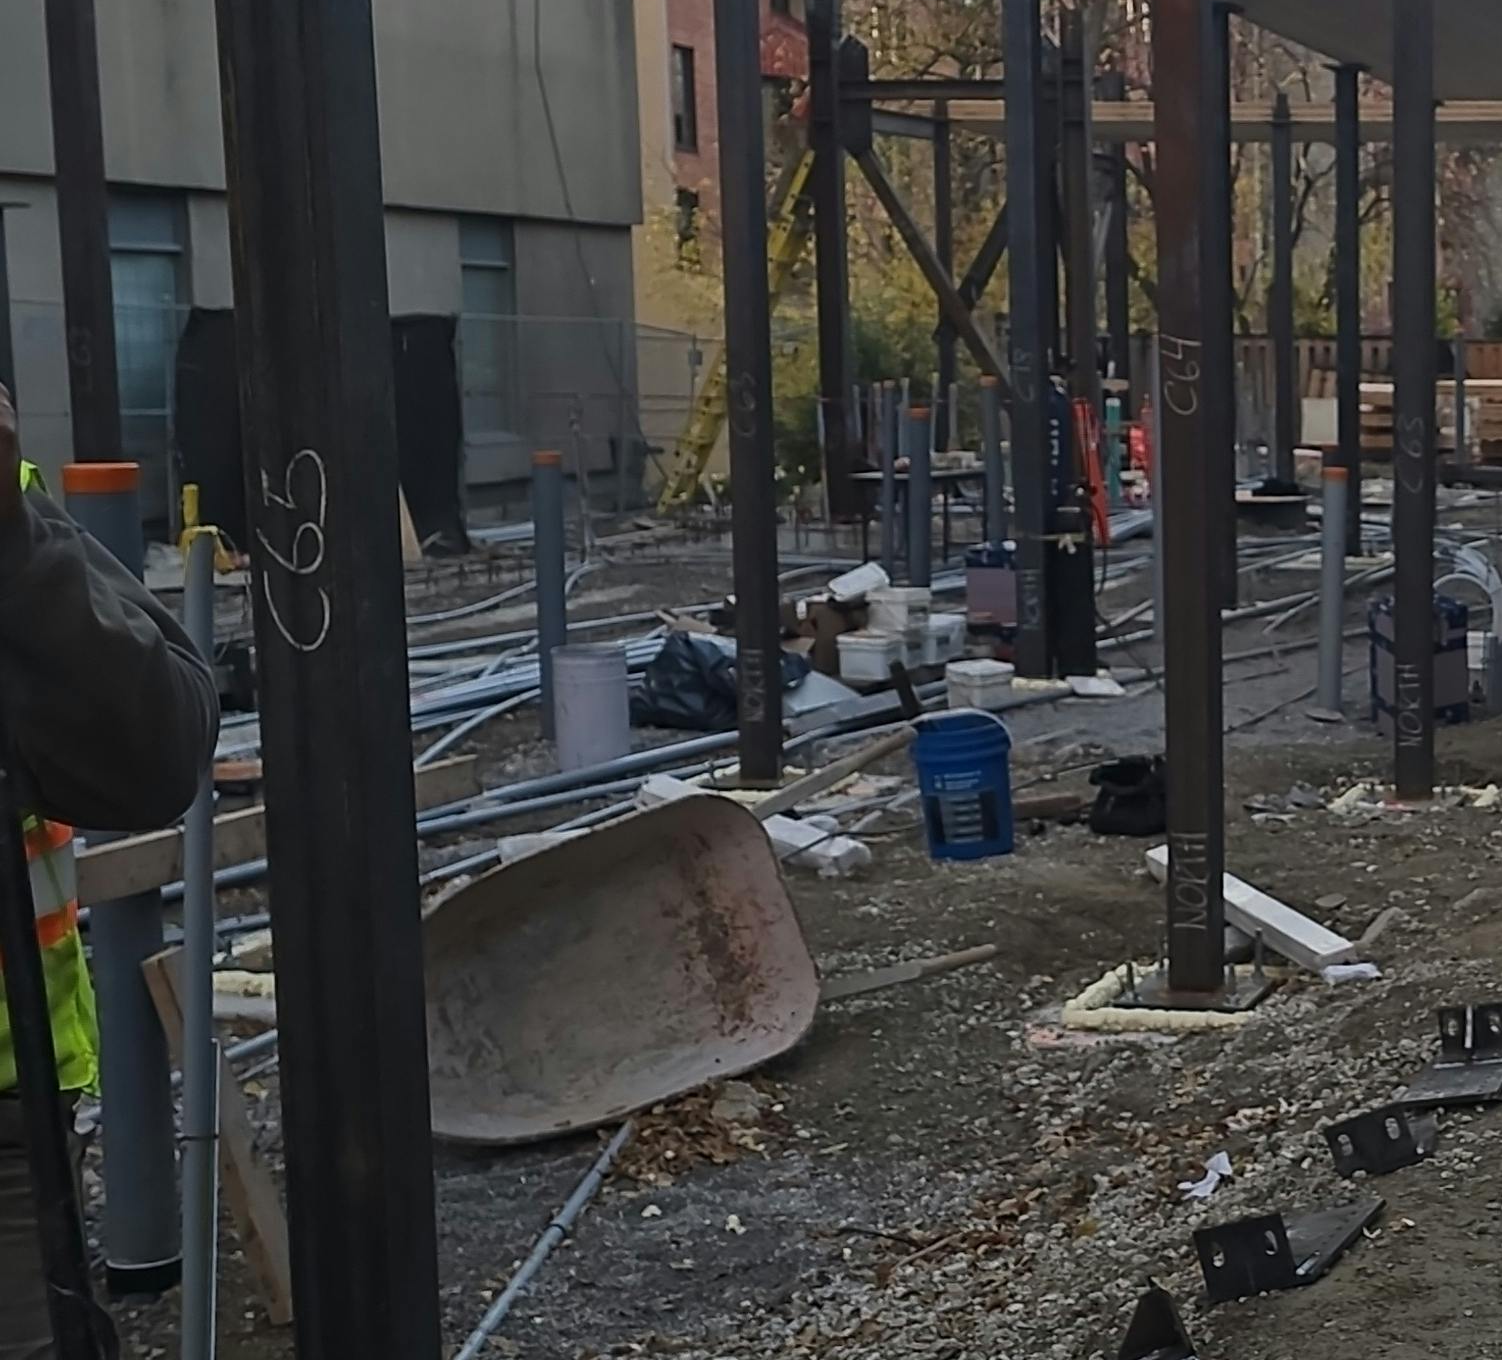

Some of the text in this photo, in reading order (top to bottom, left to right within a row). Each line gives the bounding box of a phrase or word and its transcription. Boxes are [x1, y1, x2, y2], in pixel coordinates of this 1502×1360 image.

[1160, 333, 1203, 417] C64
[256, 447, 331, 653] C65
[1171, 831, 1209, 931] NORTH
